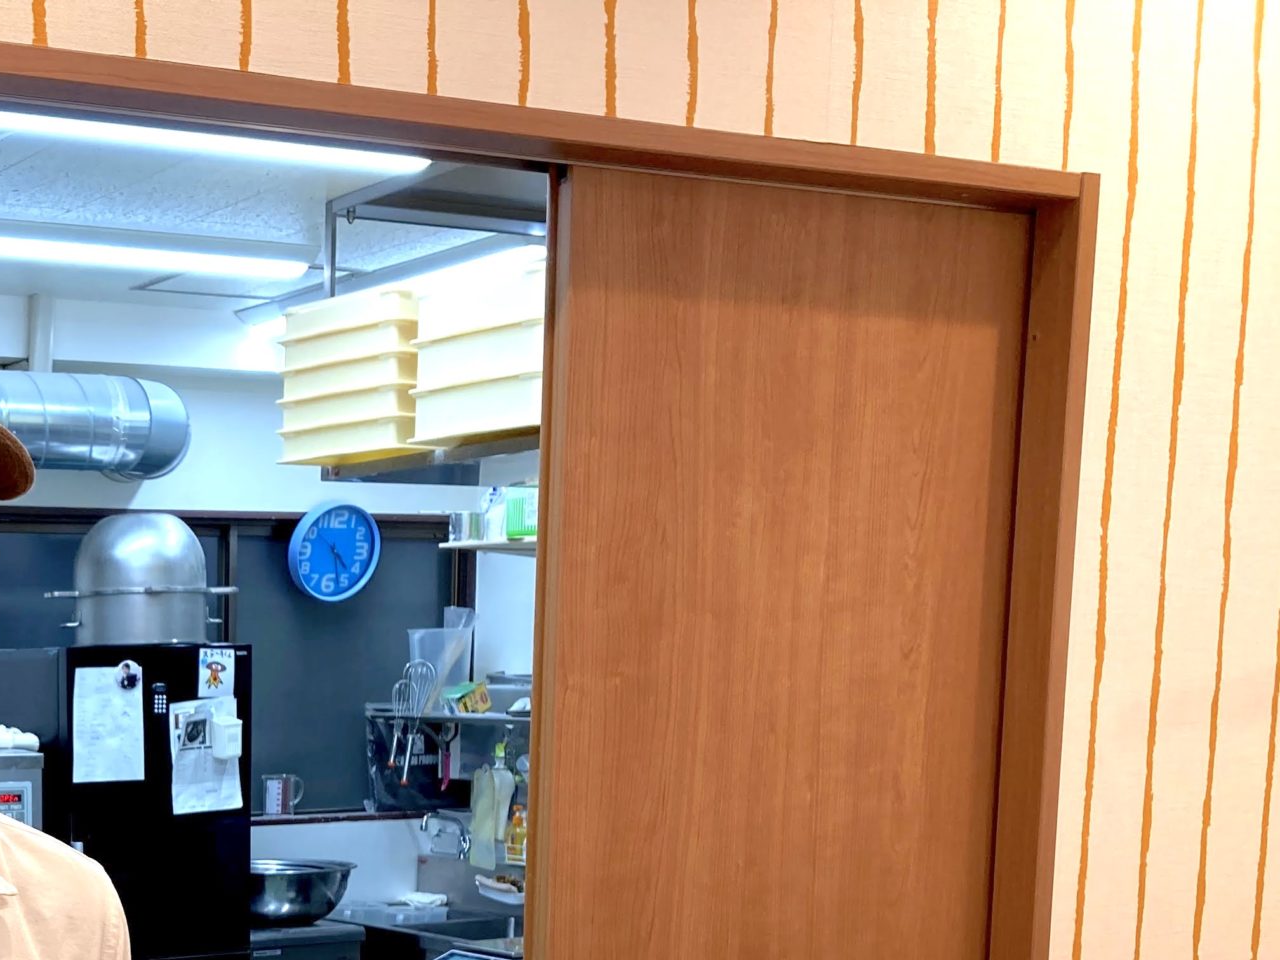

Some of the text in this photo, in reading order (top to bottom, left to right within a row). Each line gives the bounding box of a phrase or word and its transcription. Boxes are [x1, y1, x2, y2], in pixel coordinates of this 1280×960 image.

[319, 514, 328, 528] 11
[329, 510, 349, 529] 12
[350, 515, 356, 528] 1
[355, 527, 365, 540] 2
[299, 542, 312, 560] 9
[353, 542, 368, 560] 3
[301, 562, 310, 574] 8
[351, 562, 360, 575] 4
[309, 574, 319, 588] 7
[321, 573, 336, 593] 6
[339, 574, 349, 587] 5
